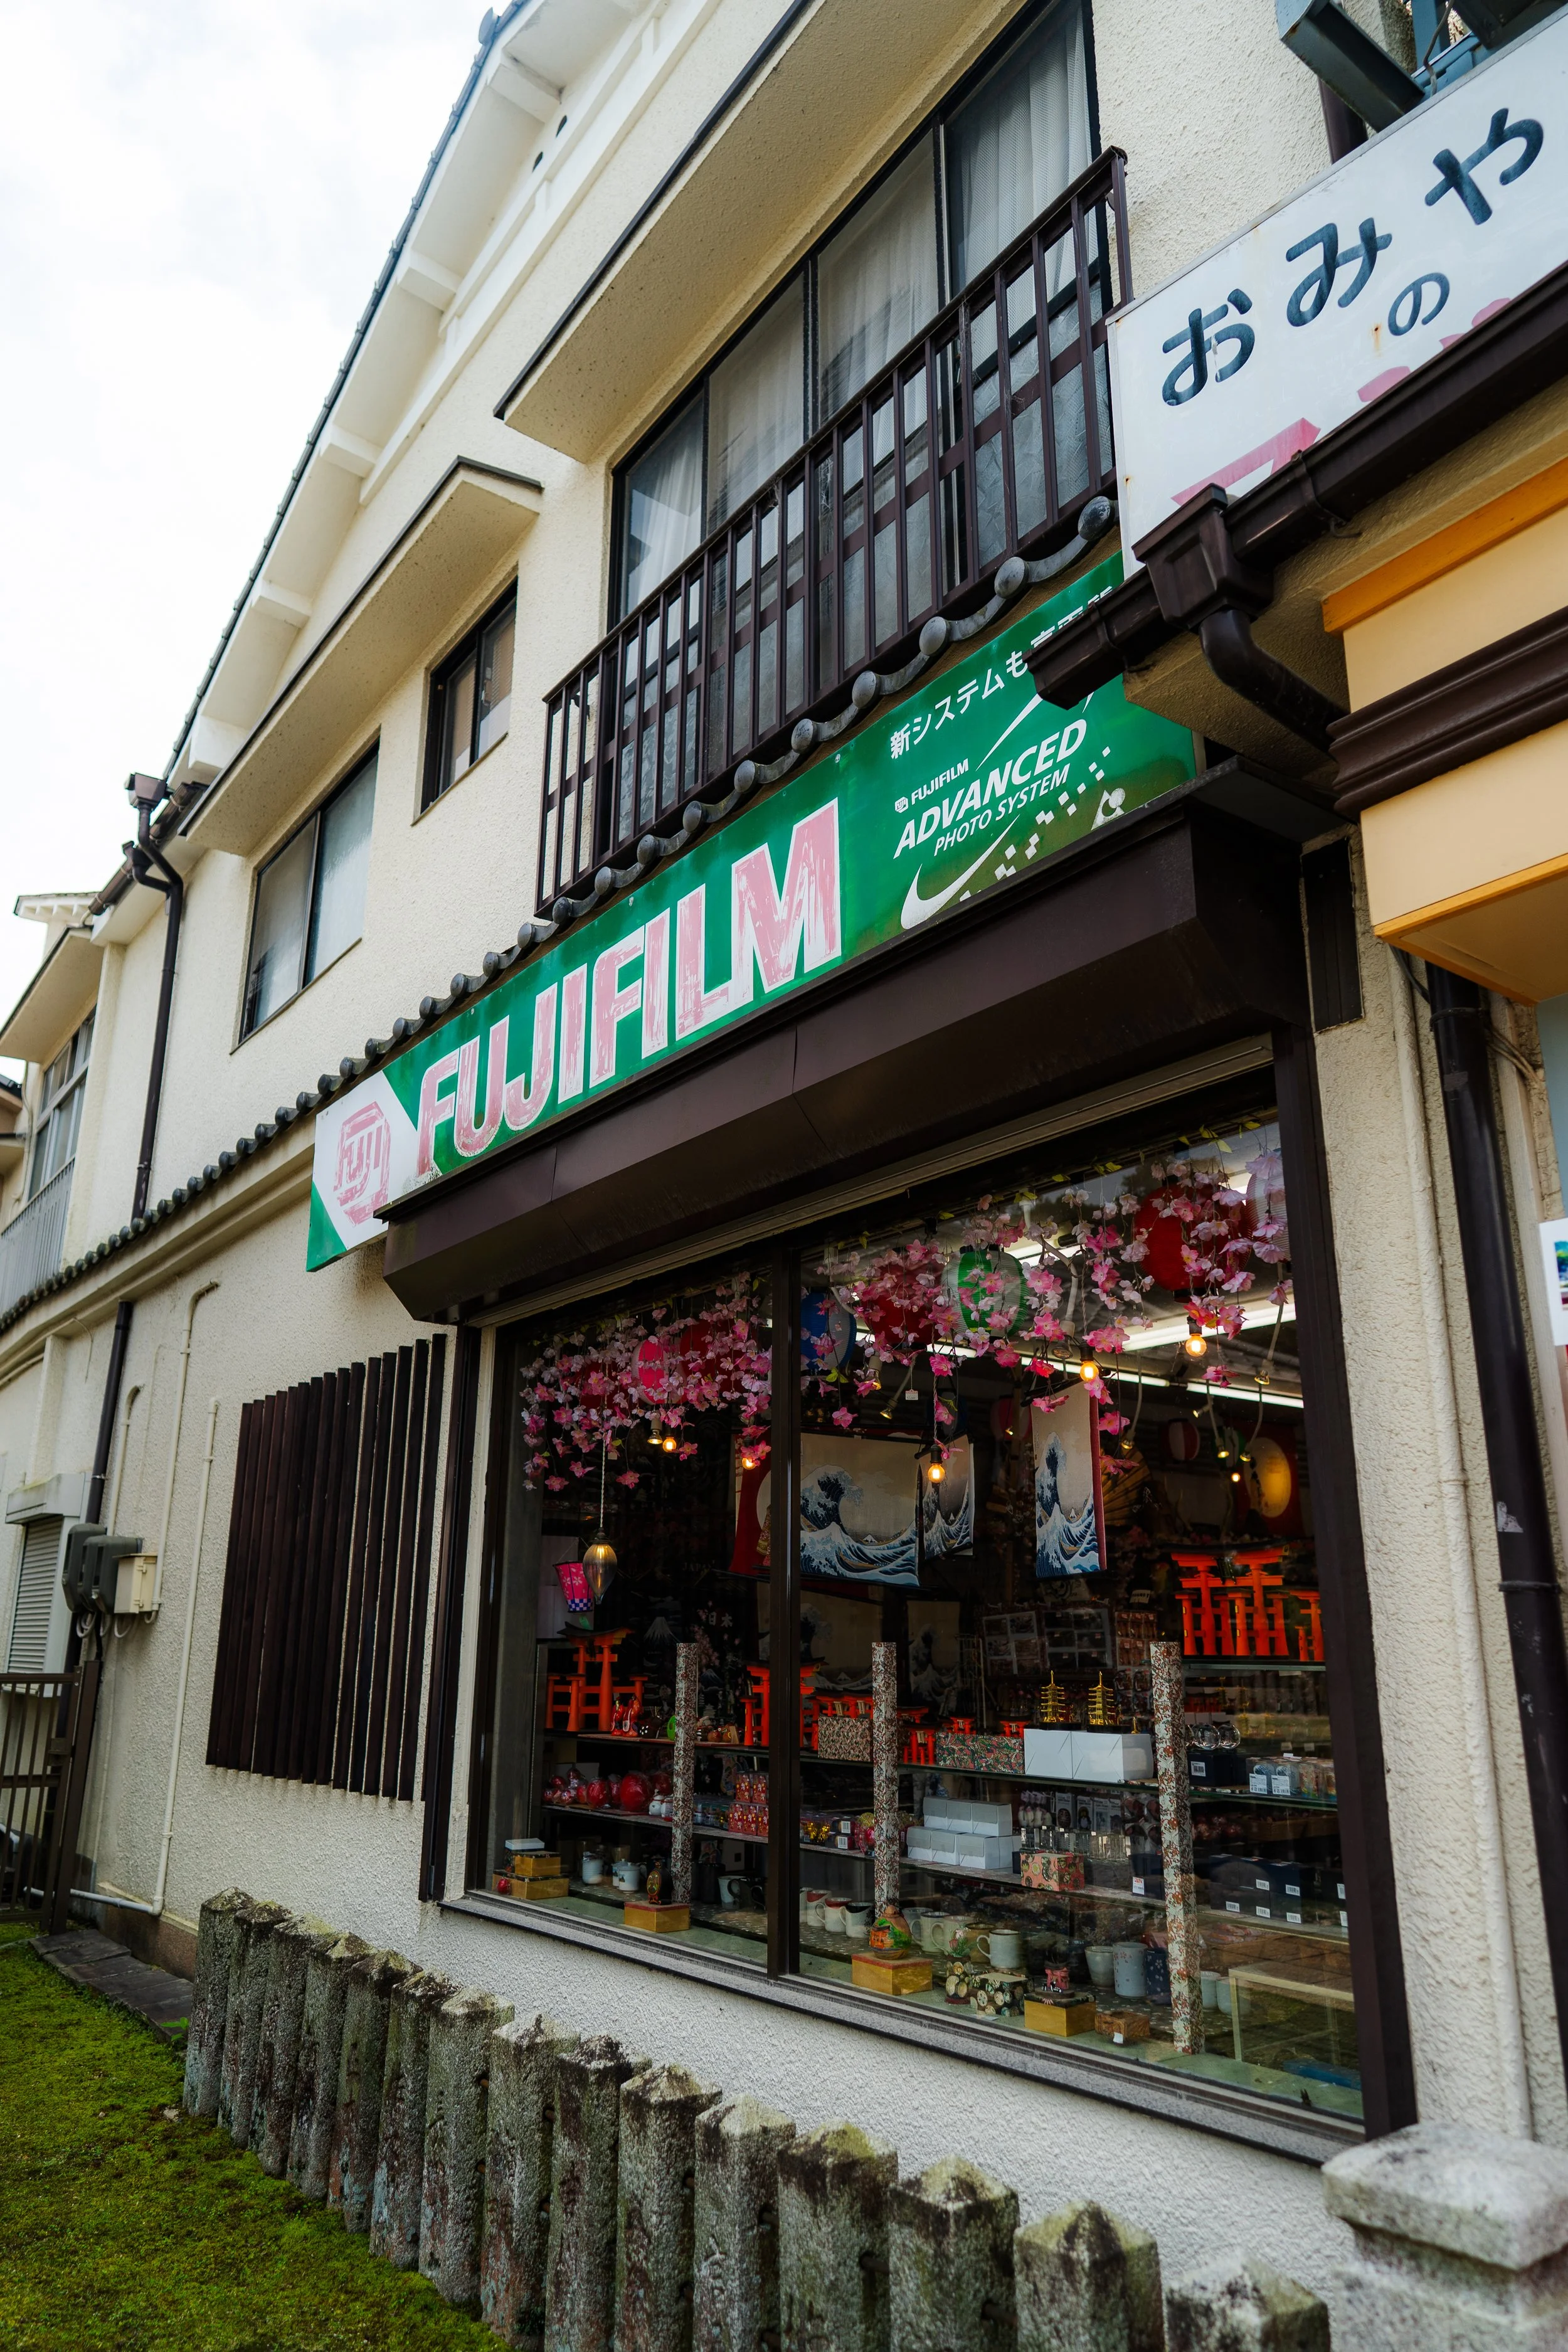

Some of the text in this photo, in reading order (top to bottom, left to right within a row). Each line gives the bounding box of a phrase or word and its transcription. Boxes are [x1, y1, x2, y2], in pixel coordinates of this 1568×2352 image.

[891, 586, 1113, 759] 新システムも
[893, 719, 1086, 859] ADVANCED
[911, 758, 968, 805] FUJIFILM
[934, 763, 1070, 856] PHOTO SYSTEM
[416, 797, 842, 1178] FUJIFILM
